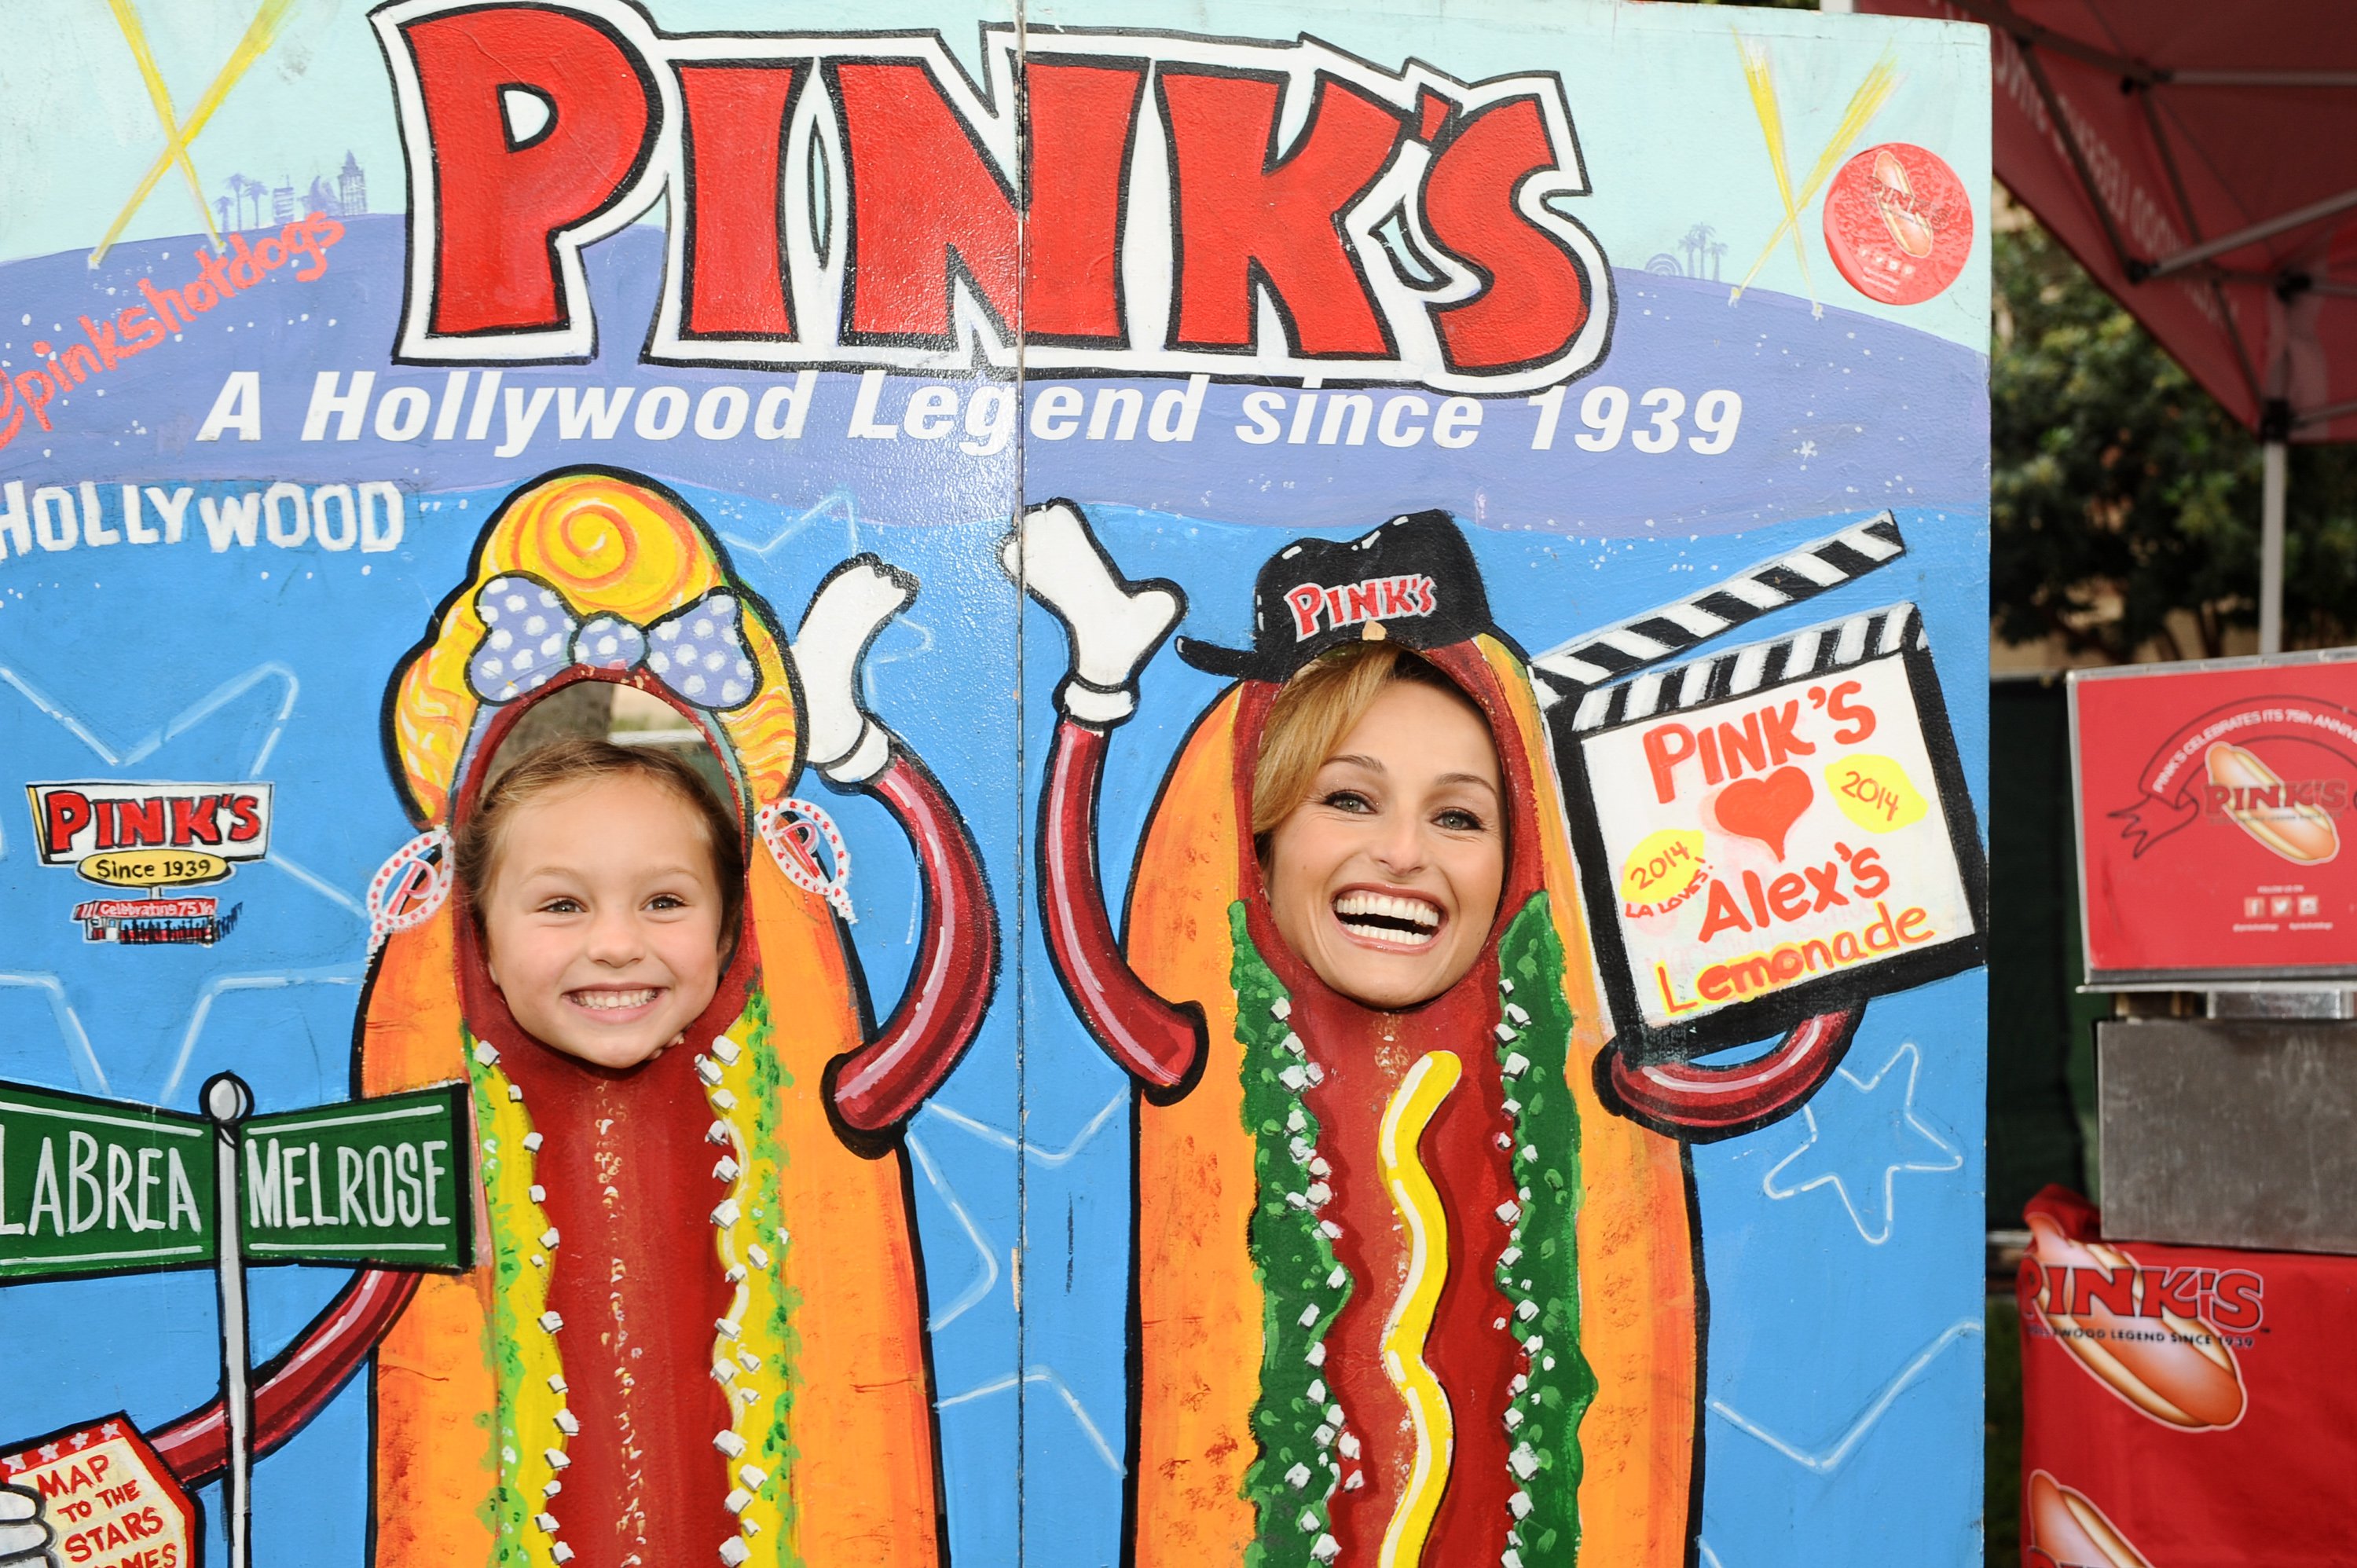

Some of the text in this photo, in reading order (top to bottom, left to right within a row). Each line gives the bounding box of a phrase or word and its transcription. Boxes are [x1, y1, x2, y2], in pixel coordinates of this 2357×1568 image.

[369, 0, 1617, 397] PINK'S
[196, 371, 1743, 459] A Hollywood Legend since 1939
[0, 480, 404, 562] HOLLYWOOD
[1284, 573, 1437, 642] PINK'S
[1643, 680, 1876, 804] PINK'S
[2262, 709, 2284, 723] ITS
[45, 789, 262, 854] PINK'S
[1841, 771, 1899, 822] 2014
[96, 859, 211, 878] Since 1939
[1630, 841, 1690, 890] 2014
[1699, 842, 1890, 943] Alex's
[101, 903, 177, 917] Celebrating
[177, 902, 196, 917] 75
[1657, 901, 1934, 1013] Lemonade
[245, 1139, 450, 1228] MELROSE
[2016, 1255, 2264, 1333] PINK'S
[2110, 1329, 2165, 1342] LEGEND
[2171, 1332, 2211, 1346] SINCE
[2218, 1335, 2254, 1349] 1939
[36, 1454, 108, 1500] MAP
[57, 1479, 141, 1523] TO THE
[64, 1506, 163, 1563] STARS
[93, 1542, 178, 1568] MES
